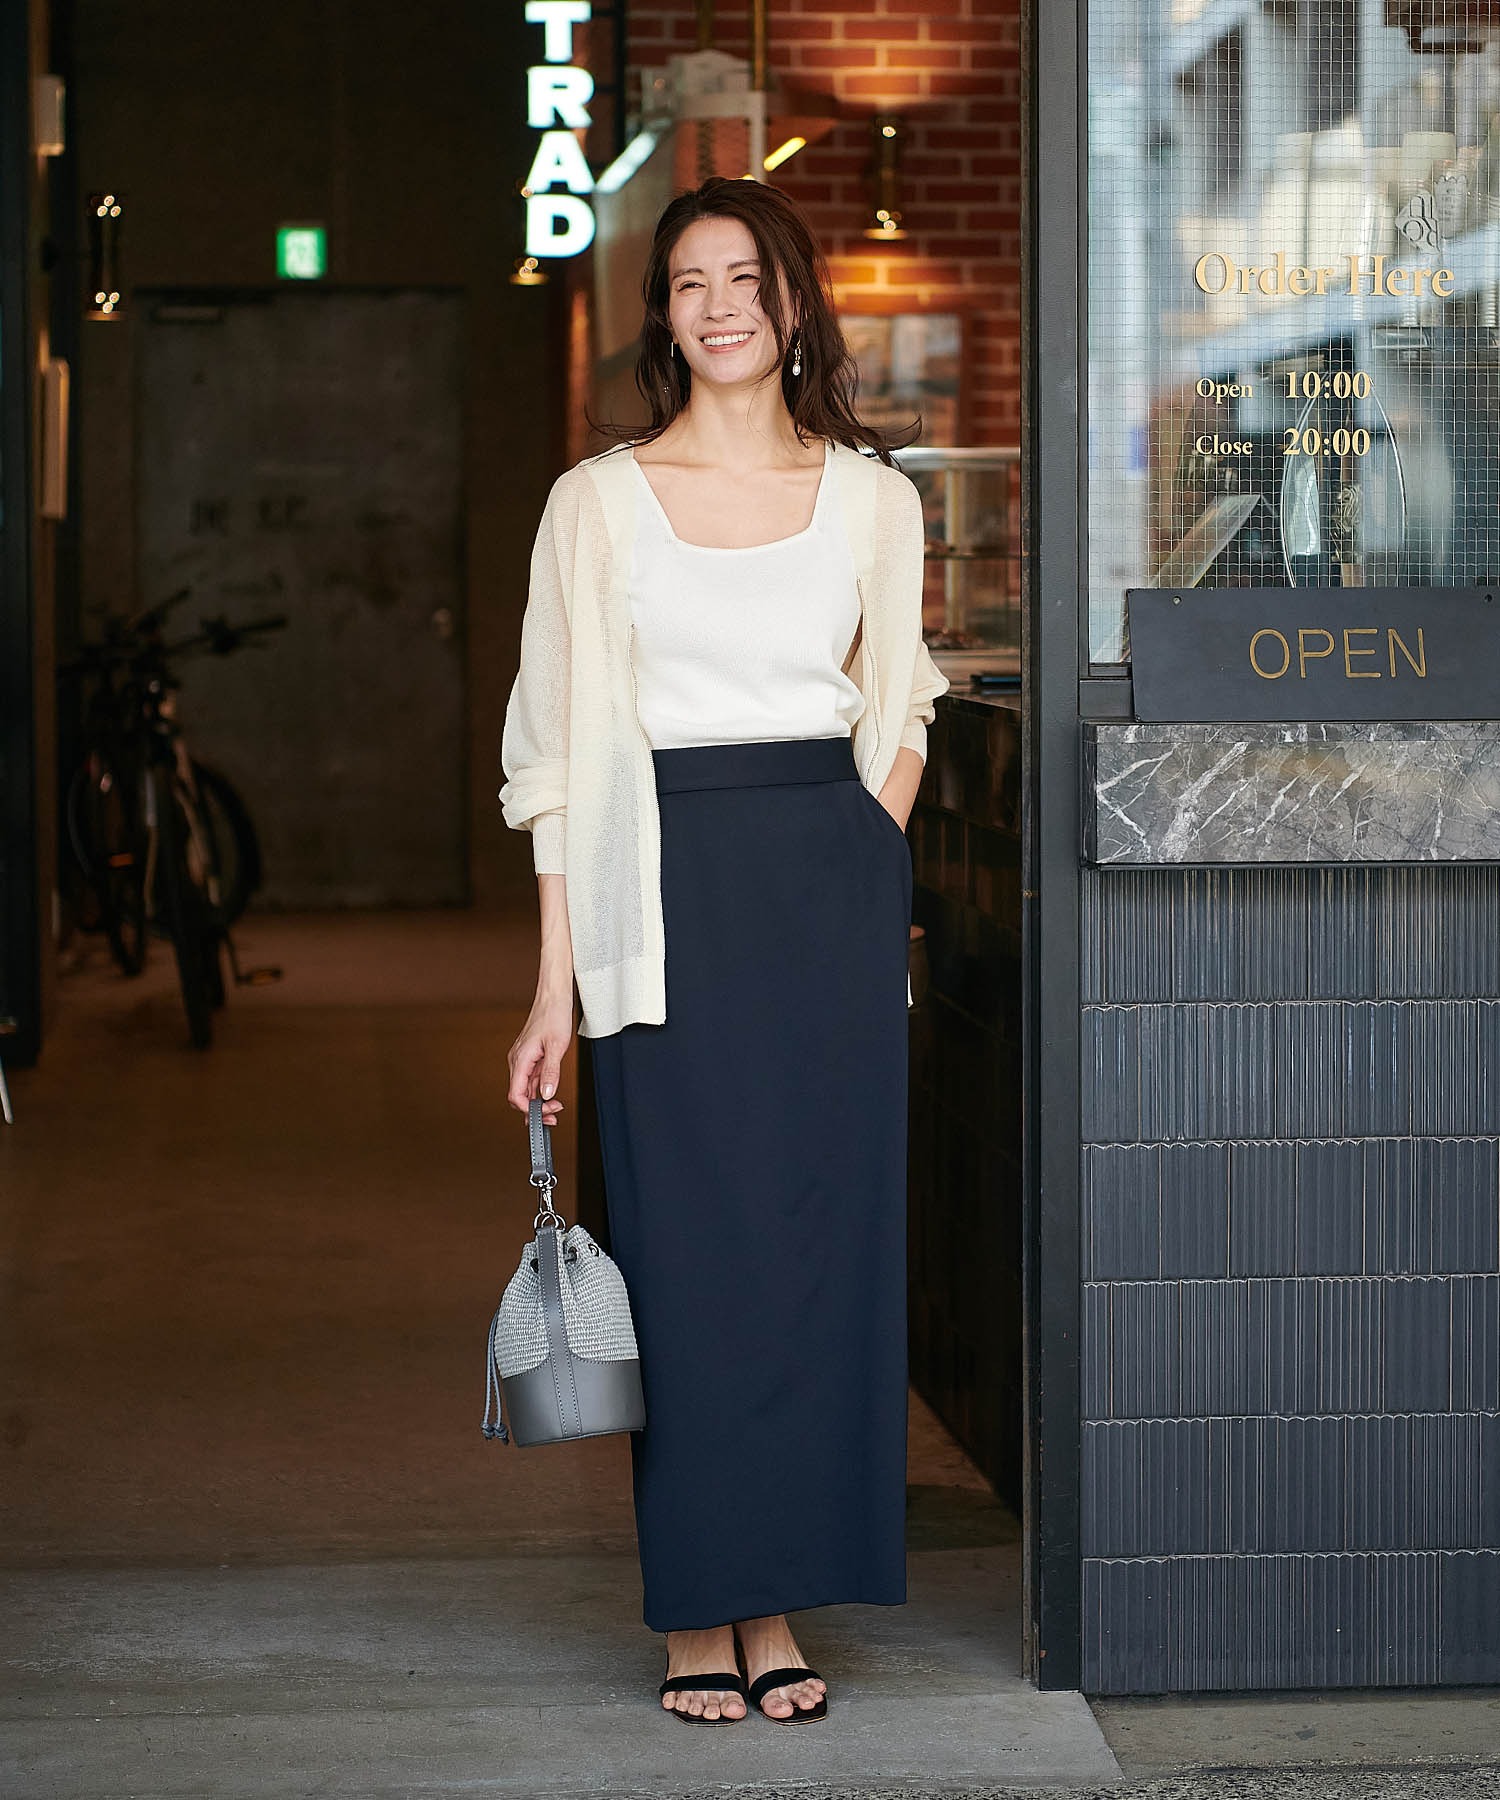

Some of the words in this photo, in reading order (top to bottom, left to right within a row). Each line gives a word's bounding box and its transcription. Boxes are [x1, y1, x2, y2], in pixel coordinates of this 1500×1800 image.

[525, 1, 596, 258] TRAD
[1195, 252, 1333, 295] Order
[1344, 255, 1455, 297] Here
[1196, 378, 1253, 404] Open
[1285, 371, 1371, 399] 10:00
[1196, 434, 1253, 456] Close
[1282, 428, 1370, 456] 20:00
[1250, 628, 1426, 679] OPEN
